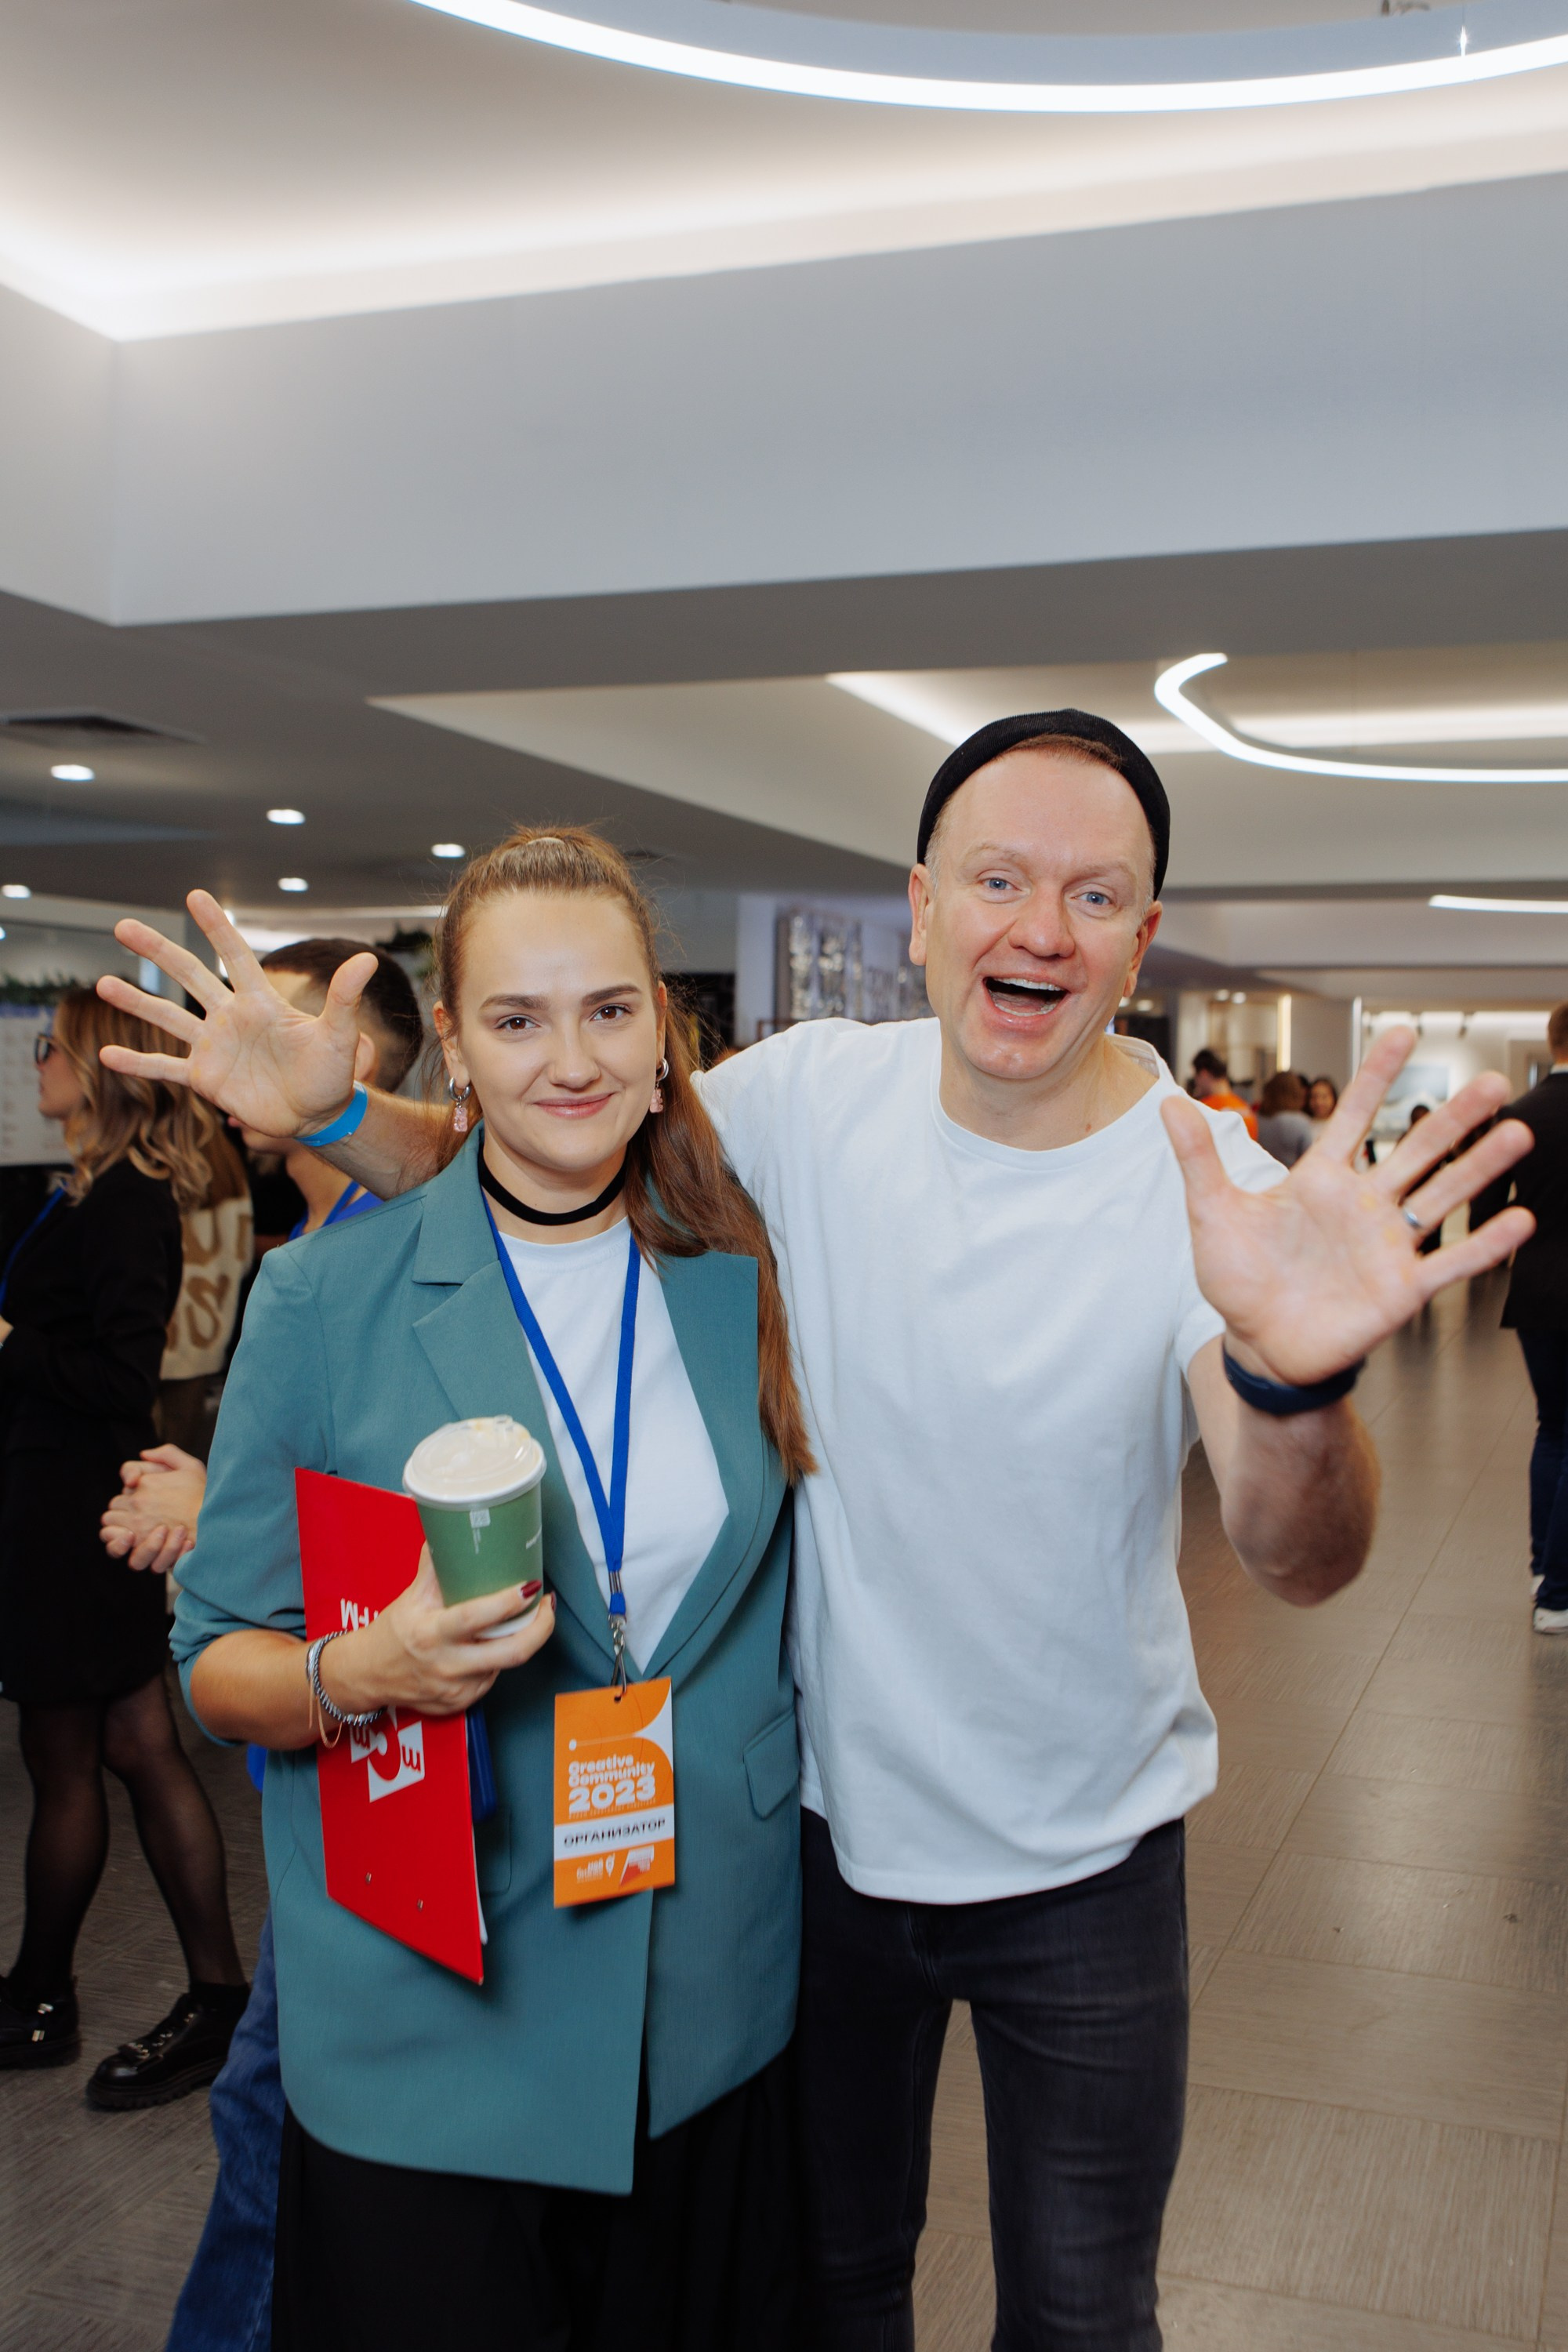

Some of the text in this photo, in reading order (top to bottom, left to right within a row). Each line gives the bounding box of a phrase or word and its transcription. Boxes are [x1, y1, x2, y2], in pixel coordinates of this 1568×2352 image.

[568, 1754, 634, 1776] Creative
[568, 1762, 655, 1787] Community
[568, 1775, 656, 1813] 2023
[564, 1818, 666, 1847] ОРГАНИЗАТОР
